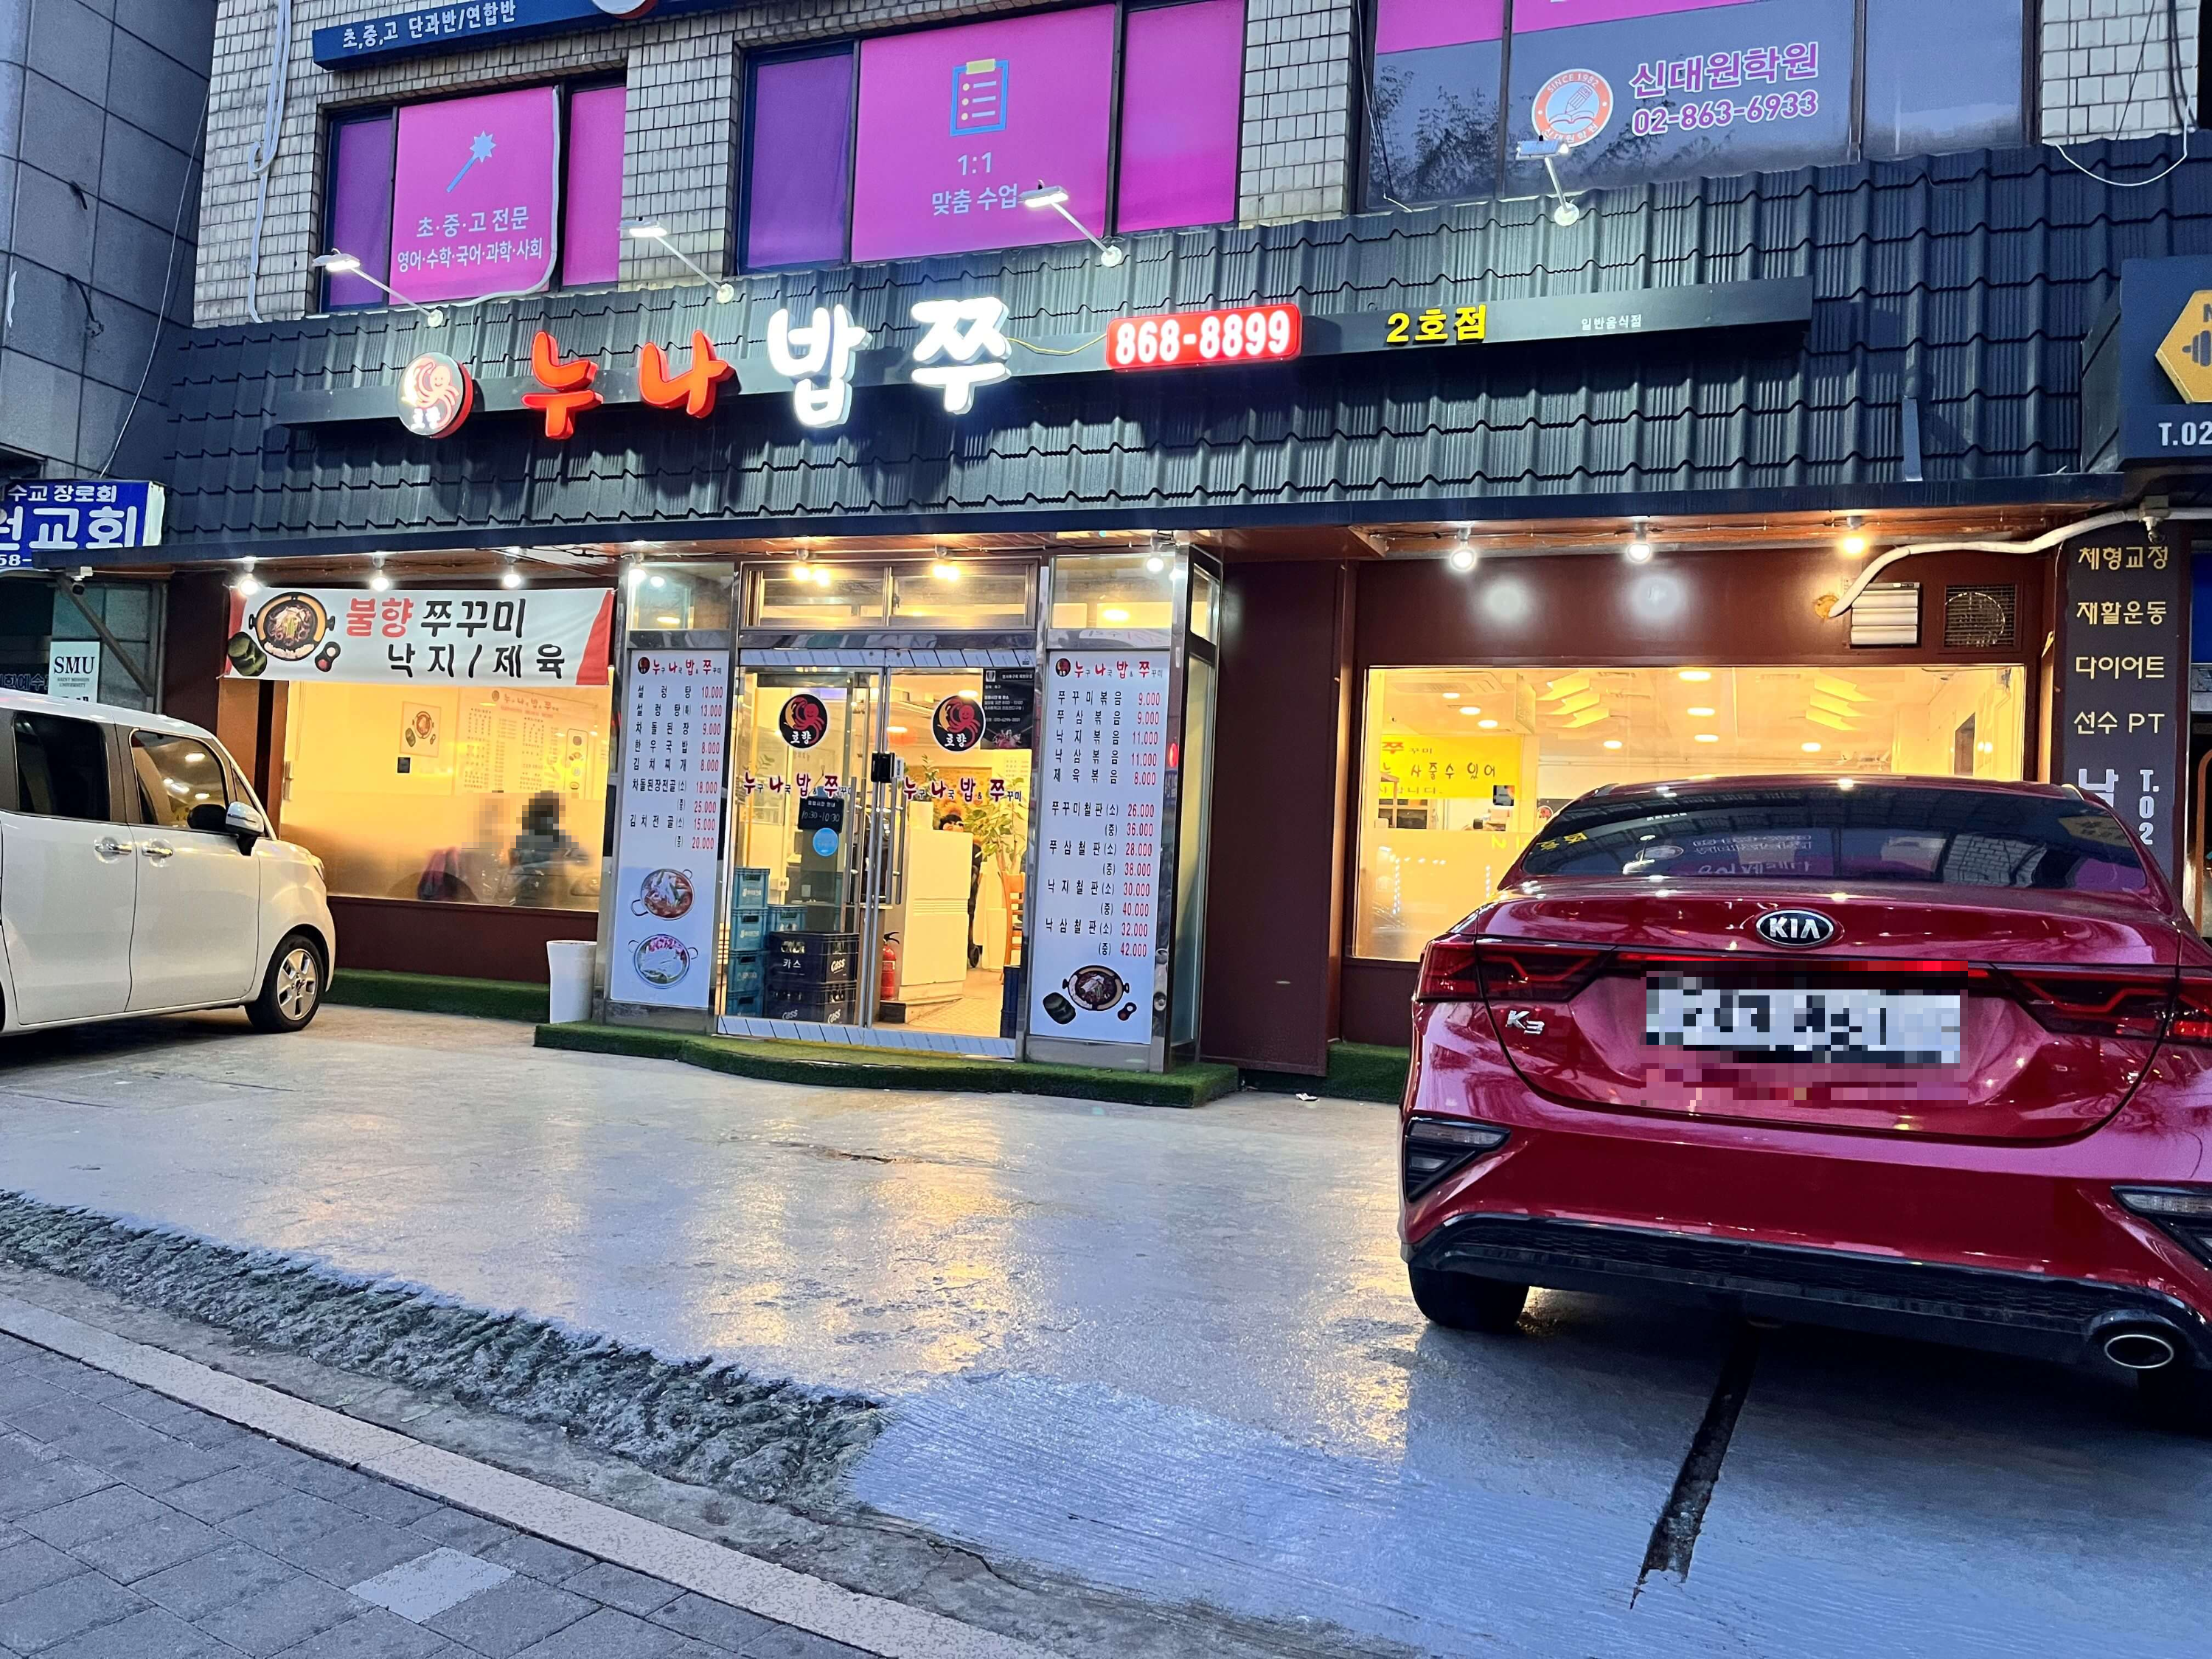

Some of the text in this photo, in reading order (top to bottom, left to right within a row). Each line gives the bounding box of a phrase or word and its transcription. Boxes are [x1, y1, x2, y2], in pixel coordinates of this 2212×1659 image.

[1628, 41, 1820, 99] 신대원학원
[1547, 73, 1599, 93] SINCE 1982
[1631, 89, 1819, 136] 02-863-6933
[957, 152, 992, 175] 1:1
[932, 183, 1018, 215] 맞춤 수업
[492, 206, 529, 230] 전문
[1387, 305, 1487, 346] 2호점
[1581, 313, 1643, 333] 일반음식점
[1115, 310, 1292, 365] 868-8899
[1, 484, 117, 503] 수교 장로회
[2078, 546, 2170, 571] 체형교정
[346, 597, 526, 639] 불향 쭈꾸미
[2076, 600, 2167, 625] 재활운동
[54, 656, 95, 675] SMU
[2075, 656, 2165, 680] 다이어트
[1138, 692, 1161, 706] 9.000
[1137, 712, 1159, 725] 9.000
[2073, 711, 2166, 735] 선수 PT
[1133, 731, 1158, 745] 11.000
[1131, 753, 1157, 766] 11.000
[1134, 771, 1156, 785] 8.000
[1128, 804, 1155, 817] 26.000
[1127, 823, 1153, 836] 36.000
[1125, 843, 1152, 856] 28.000
[1124, 862, 1151, 876] 38.000
[1124, 883, 1150, 897] 30.000
[1122, 902, 1149, 917] 40.000
[1121, 922, 1148, 936] 32.000
[1769, 917, 1820, 939] KIA
[1121, 942, 1147, 957] 42.000
[782, 959, 802, 969] 카스
[831, 959, 846, 973] Cass
[1506, 1009, 1545, 1034] K3
